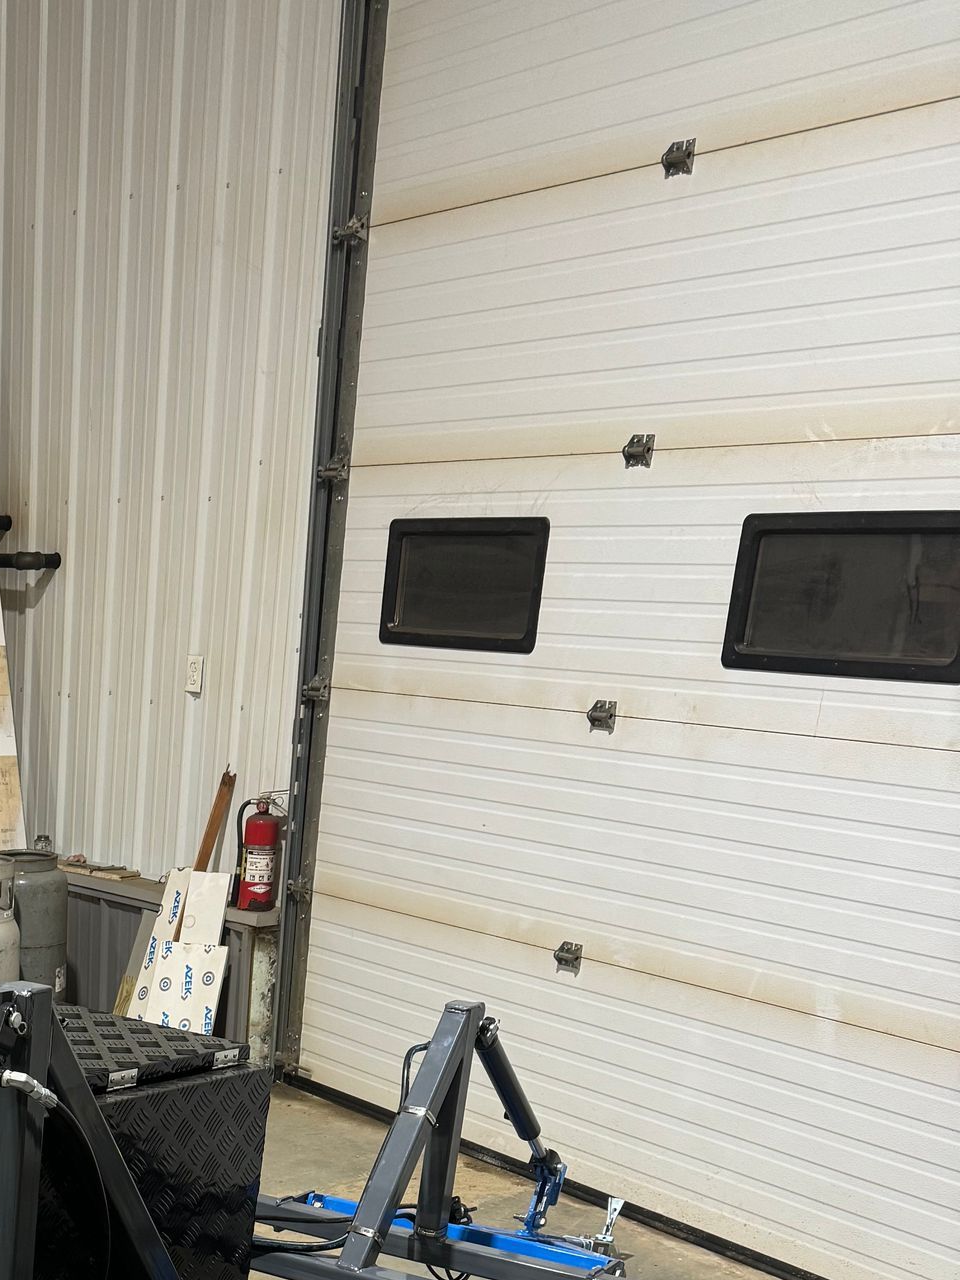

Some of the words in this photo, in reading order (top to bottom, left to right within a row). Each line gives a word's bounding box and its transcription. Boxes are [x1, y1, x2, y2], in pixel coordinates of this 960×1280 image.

[171, 890, 182, 919] AZEK
[147, 935, 158, 965] AZEK
[184, 964, 193, 996] AZEK
